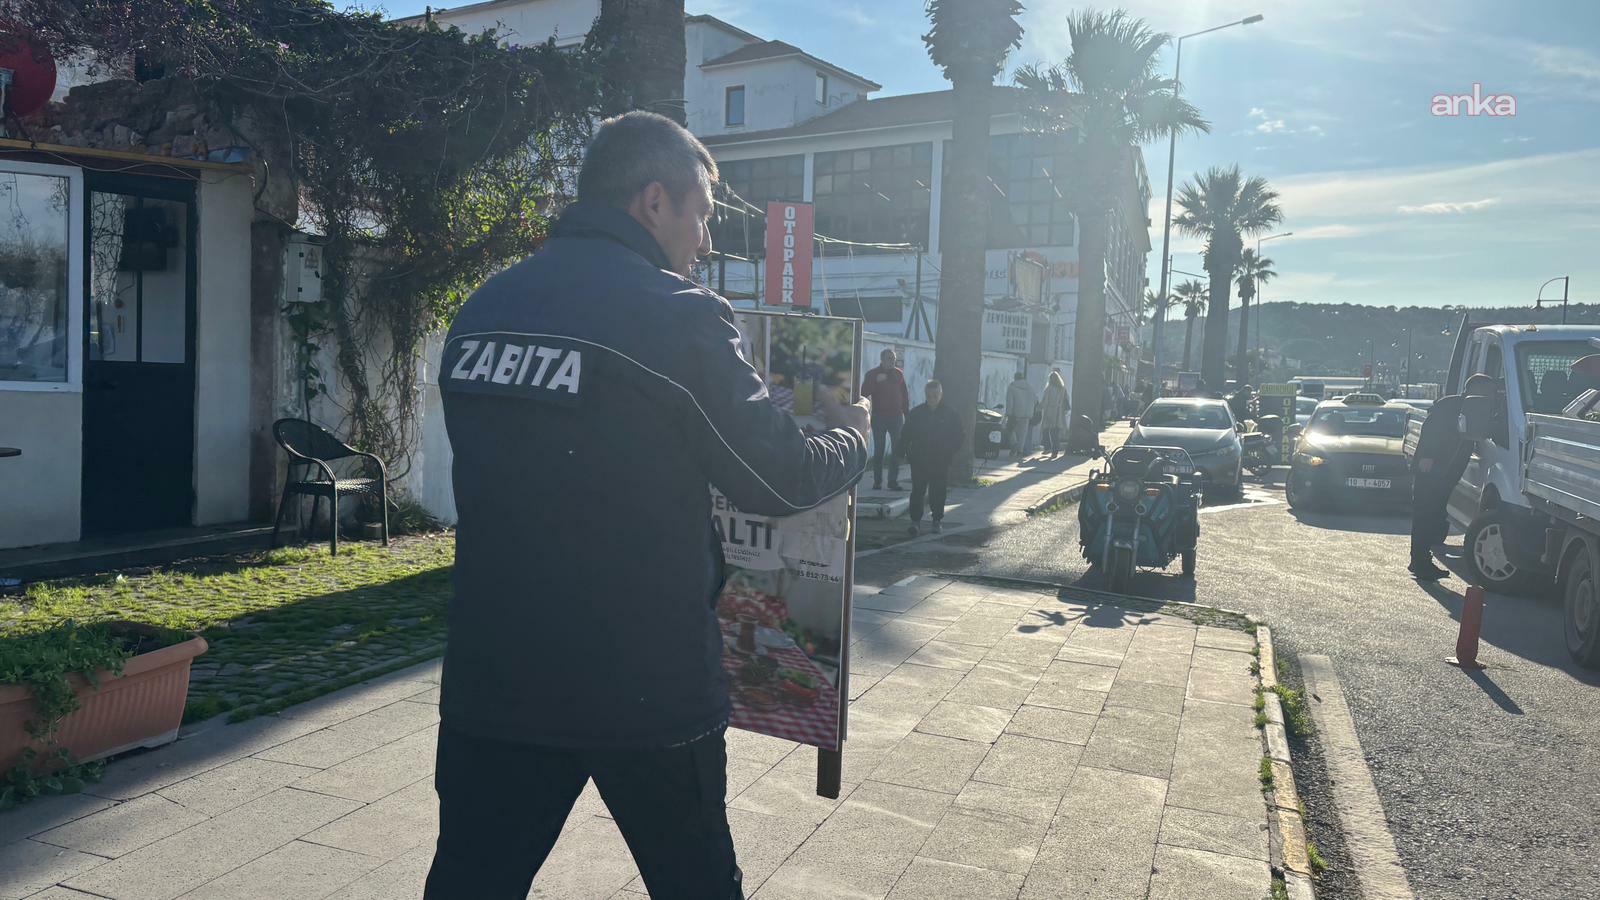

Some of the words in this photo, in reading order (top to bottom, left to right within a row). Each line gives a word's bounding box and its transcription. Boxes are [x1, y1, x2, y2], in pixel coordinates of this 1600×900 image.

[782, 206, 796, 304] OTOPARK
[451, 340, 581, 394] ZABITA
[1281, 398, 1291, 464] OTOPARK
[711, 514, 773, 550] ALTI
